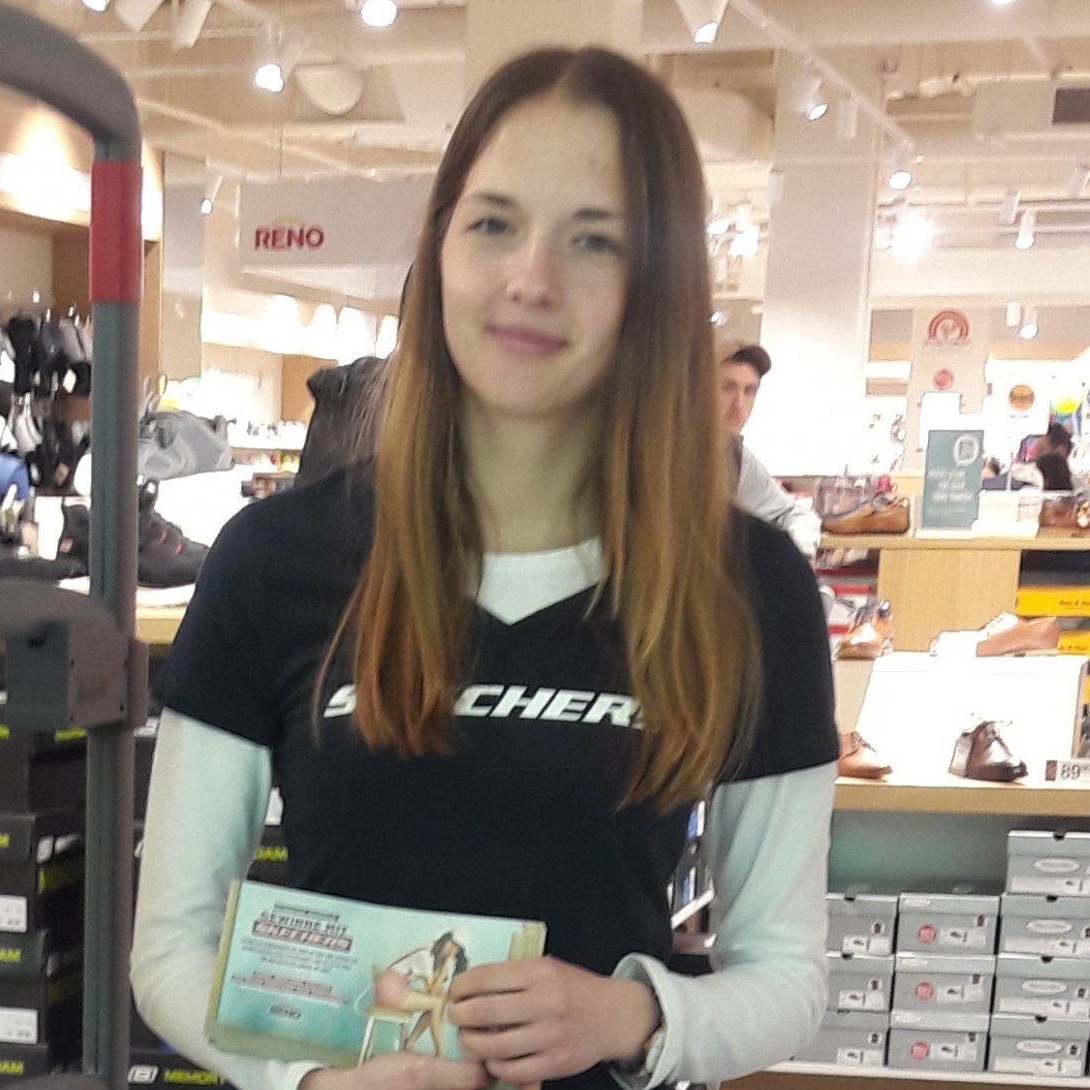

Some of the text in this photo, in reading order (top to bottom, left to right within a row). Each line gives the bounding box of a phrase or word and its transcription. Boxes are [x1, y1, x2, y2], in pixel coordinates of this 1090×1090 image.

[254, 226, 325, 252] RENO
[323, 683, 647, 730] SCHER
[165, 1068, 225, 1085] MEMOR
